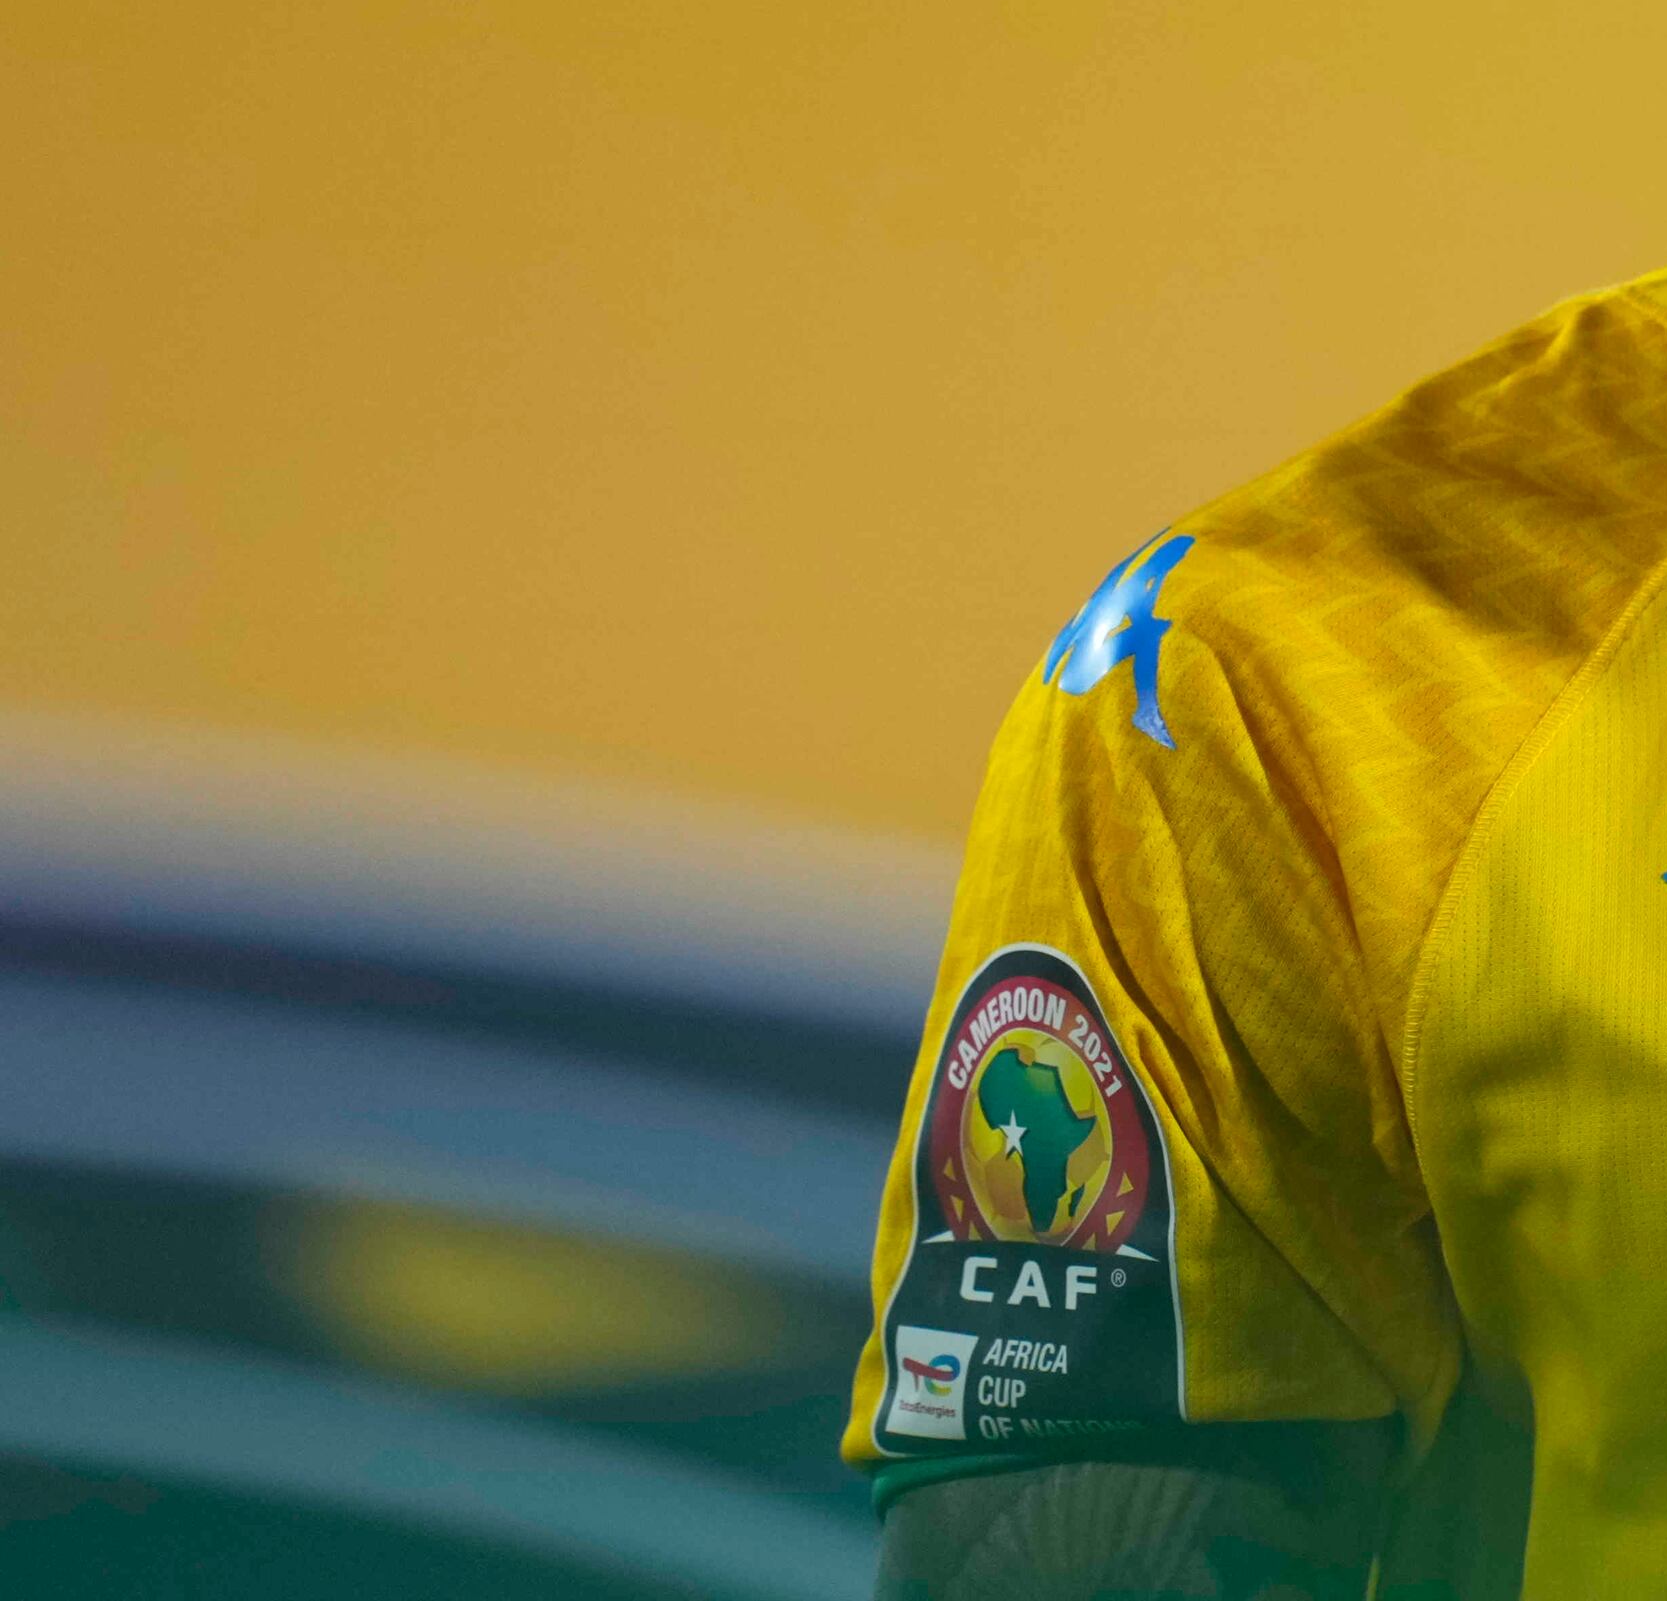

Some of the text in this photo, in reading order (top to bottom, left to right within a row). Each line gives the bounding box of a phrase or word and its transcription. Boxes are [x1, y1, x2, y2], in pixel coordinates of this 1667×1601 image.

[948, 986, 1123, 1098] CAMEROON 2021
[983, 1338, 1068, 1374] AFRICA
[978, 1375, 1026, 1408] CUP
[979, 1415, 1015, 1440] OF
